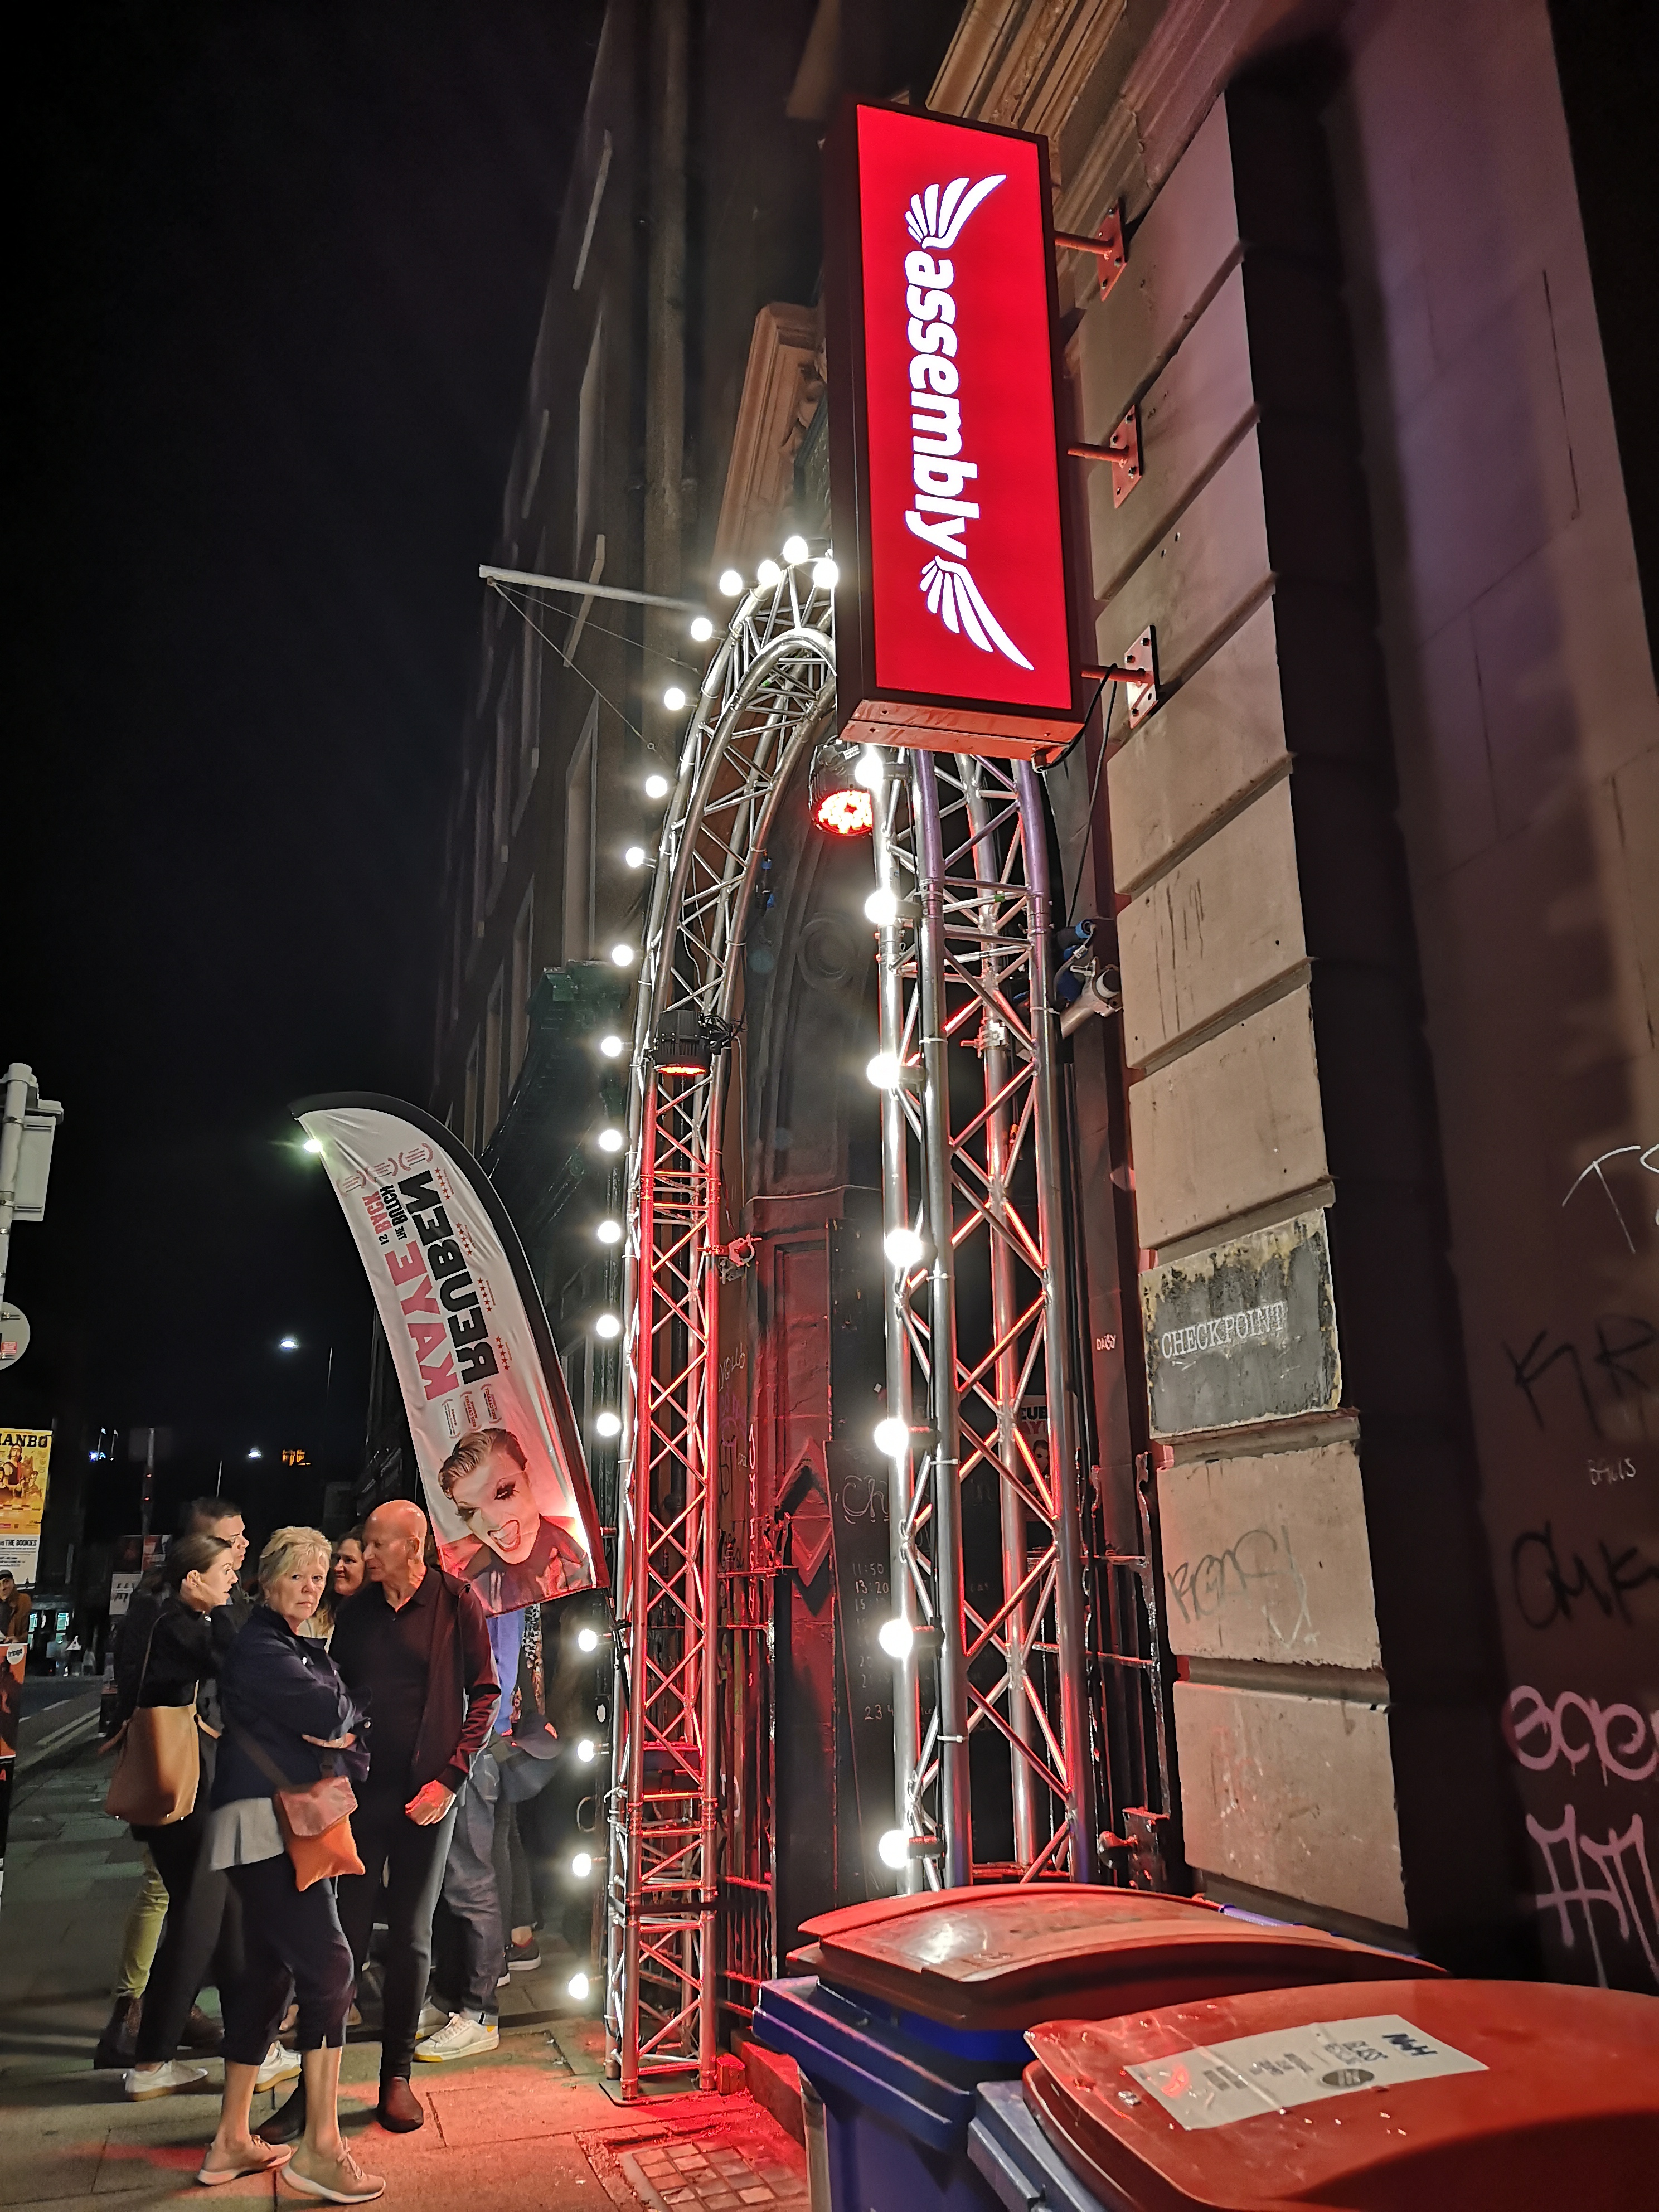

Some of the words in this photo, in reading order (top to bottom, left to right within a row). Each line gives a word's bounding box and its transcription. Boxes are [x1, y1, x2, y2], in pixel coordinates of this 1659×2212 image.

[905, 249, 981, 560] assembly
[1161, 1301, 1287, 1359] CHECKPOINT
[852, 1563, 884, 1576] 11:50
[855, 1579, 889, 1594] 13:20
